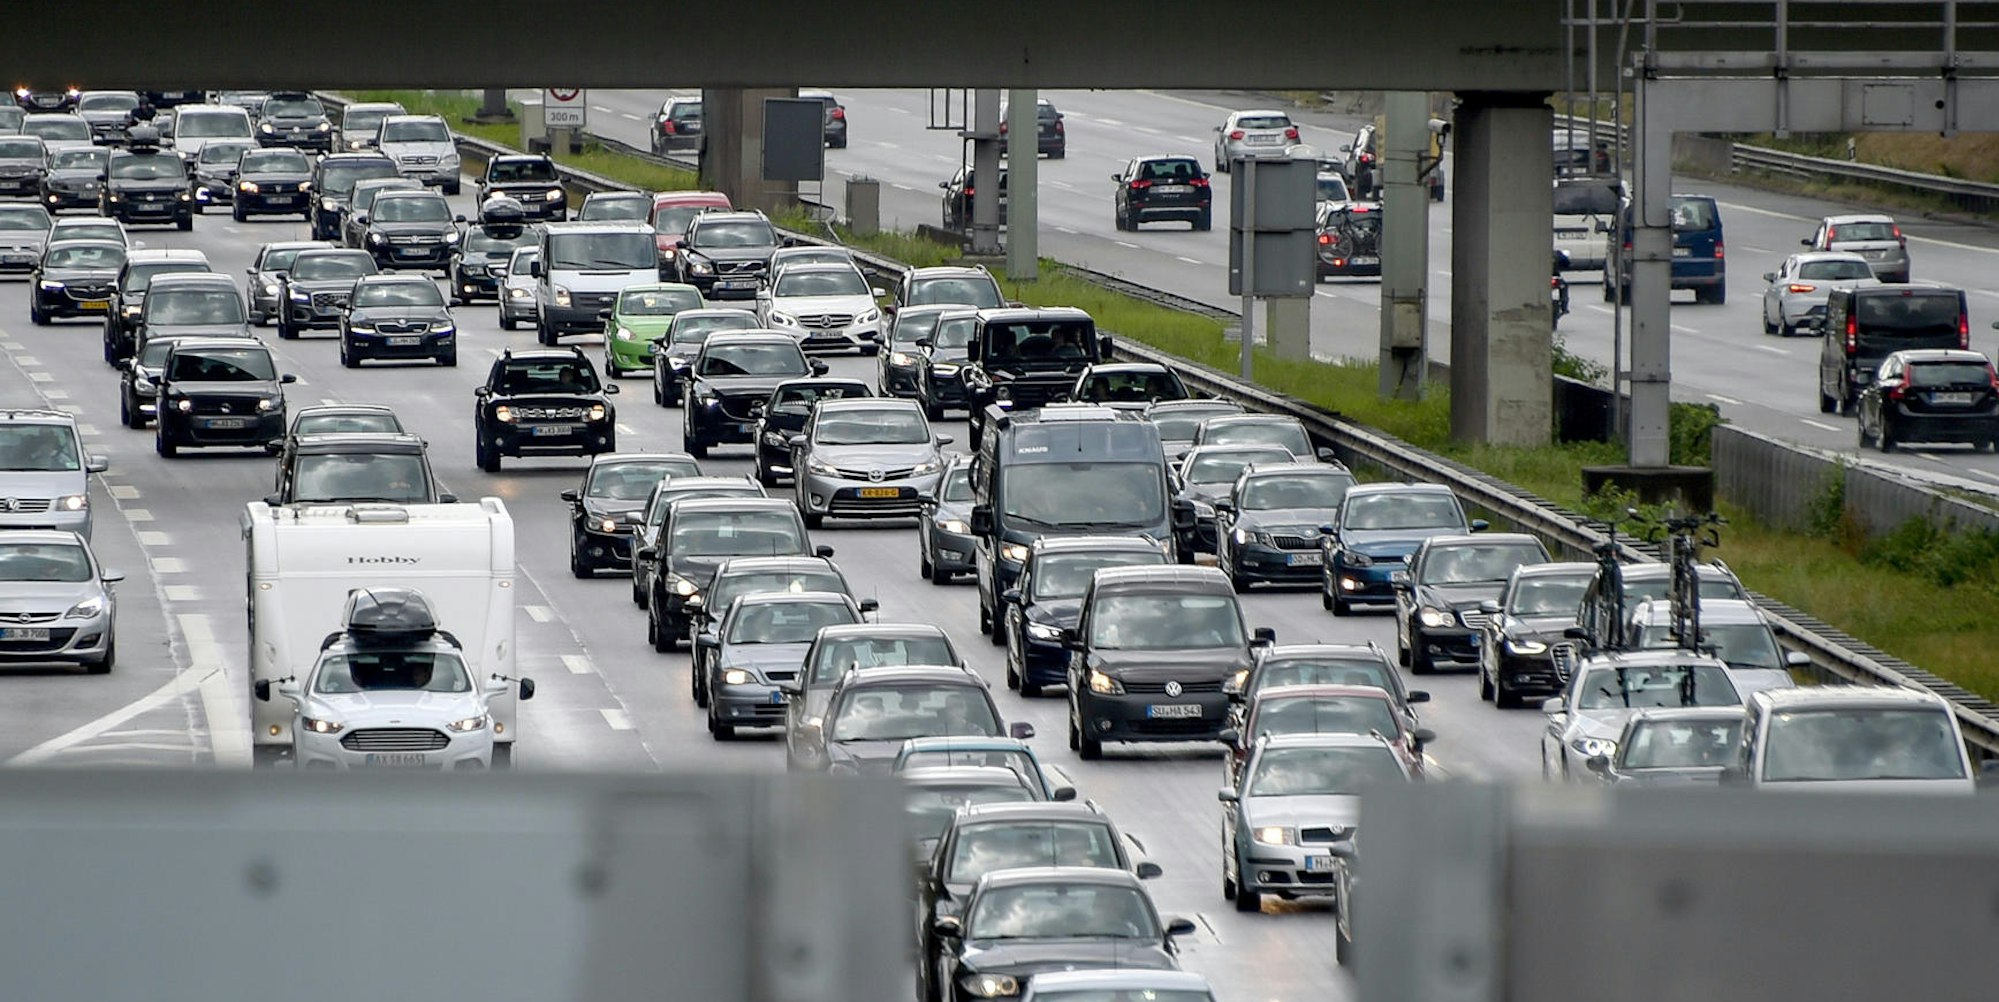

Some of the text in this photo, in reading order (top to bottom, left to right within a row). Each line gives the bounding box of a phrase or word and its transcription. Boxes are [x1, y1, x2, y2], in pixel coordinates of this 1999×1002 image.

[551, 112, 567, 121] 300
[1018, 446, 1048, 454] KNAUS
[348, 556, 421, 565] Hobby
